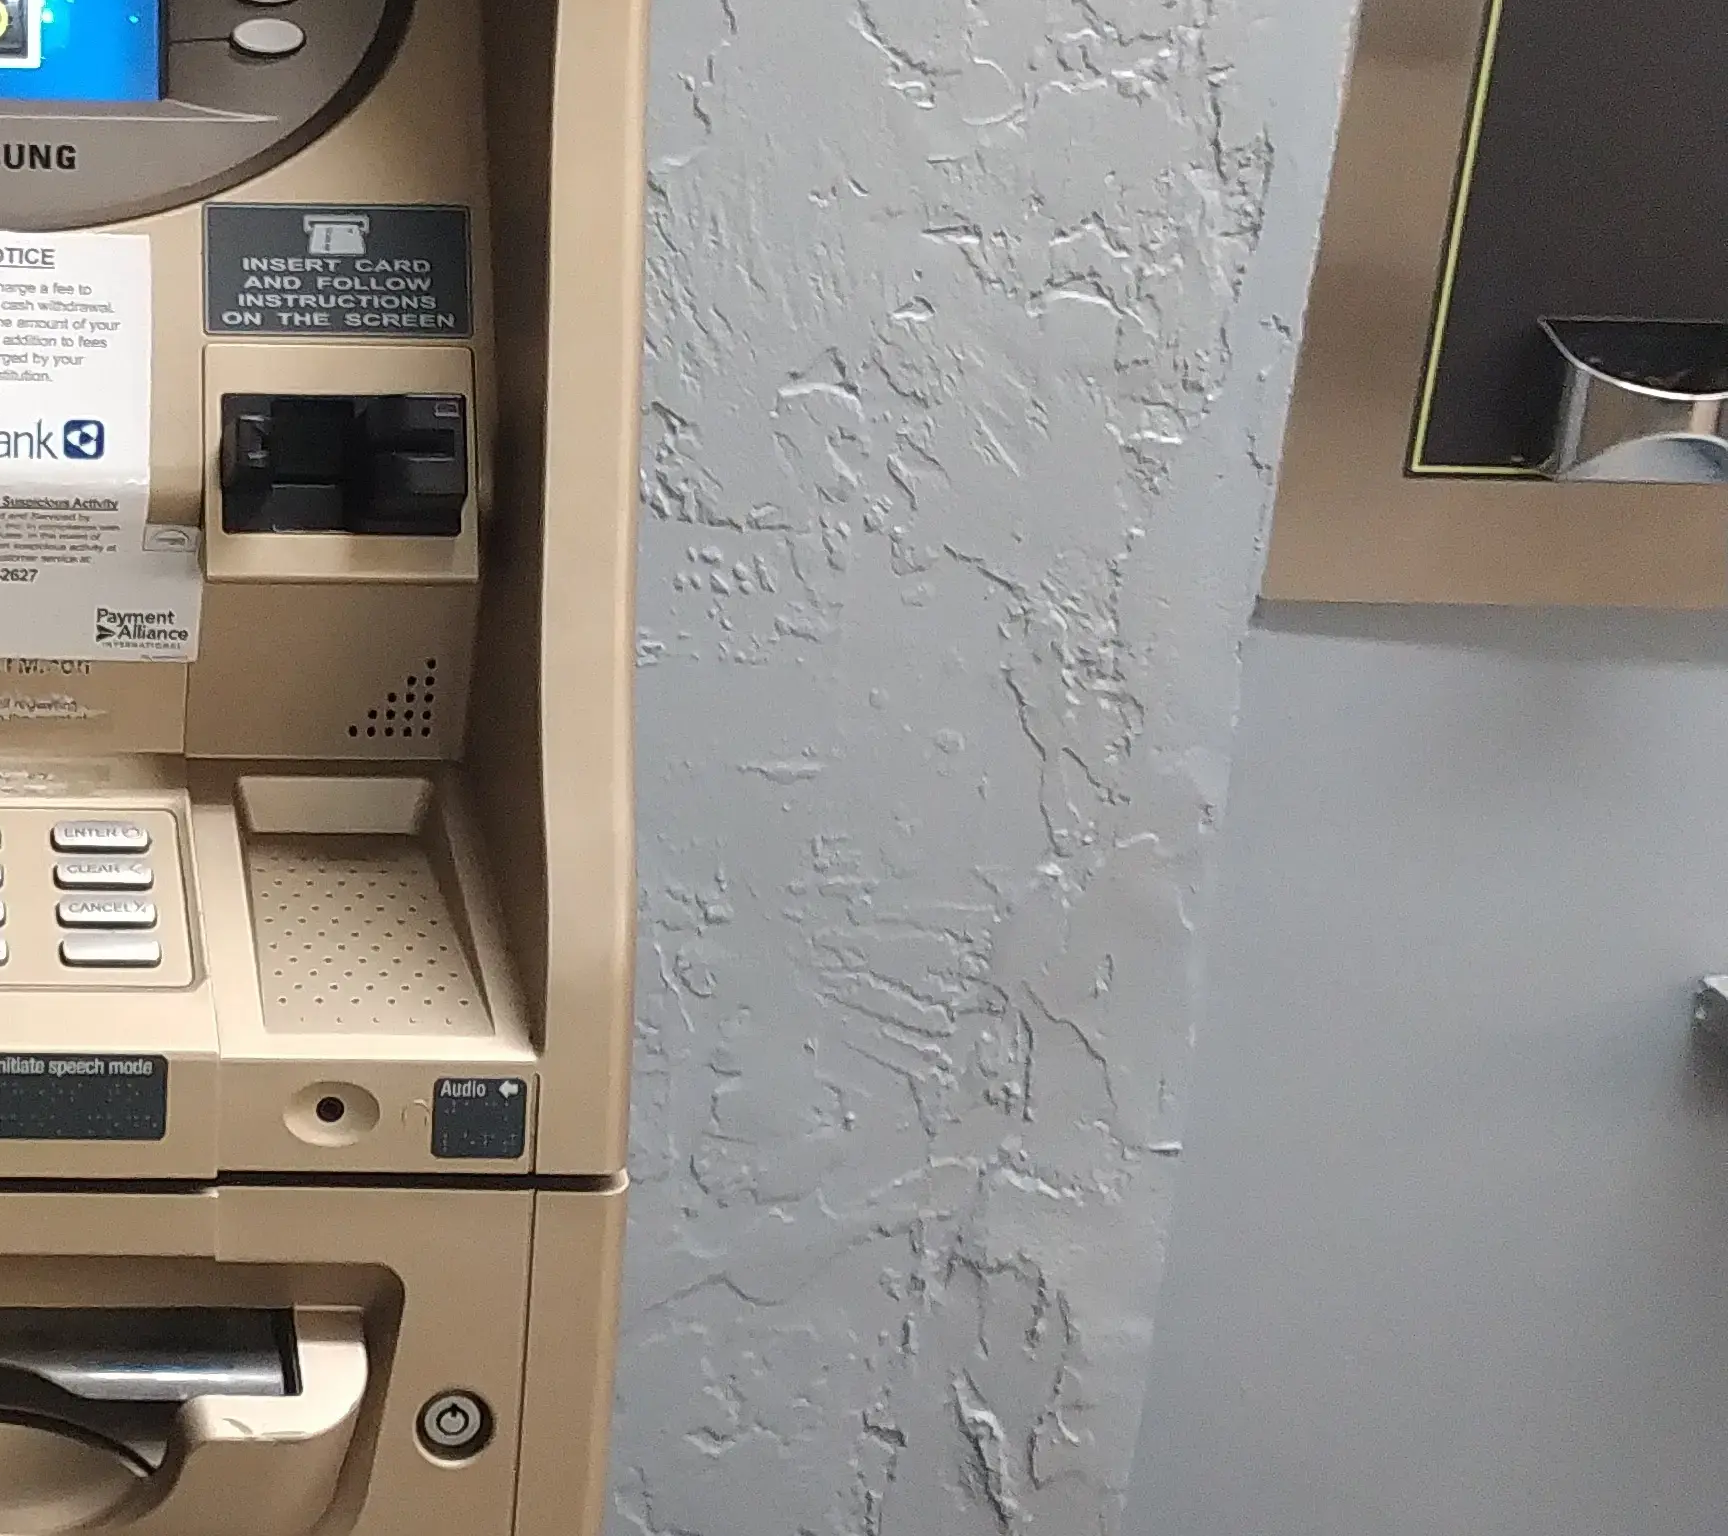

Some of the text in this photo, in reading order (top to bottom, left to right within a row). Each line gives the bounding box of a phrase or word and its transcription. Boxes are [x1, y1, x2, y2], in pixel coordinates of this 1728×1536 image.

[242, 256, 432, 274] INSERT CARD
[53, 282, 75, 295] fee
[78, 284, 93, 296] to
[243, 275, 433, 292] AND FOLLOW
[237, 293, 438, 311] INSTRUCTIONS
[72, 318, 88, 330] of
[89, 321, 121, 333] your
[221, 311, 456, 329] ON THE SCREEN
[61, 335, 75, 347] to
[78, 335, 108, 349] fees
[52, 355, 86, 368] your
[95, 607, 176, 627] Payment
[117, 624, 189, 642] Alliance
[68, 902, 132, 914] CANCEL
[47, 1058, 105, 1077] speech
[108, 1059, 153, 1075] mode
[439, 1079, 487, 1098] Audio
